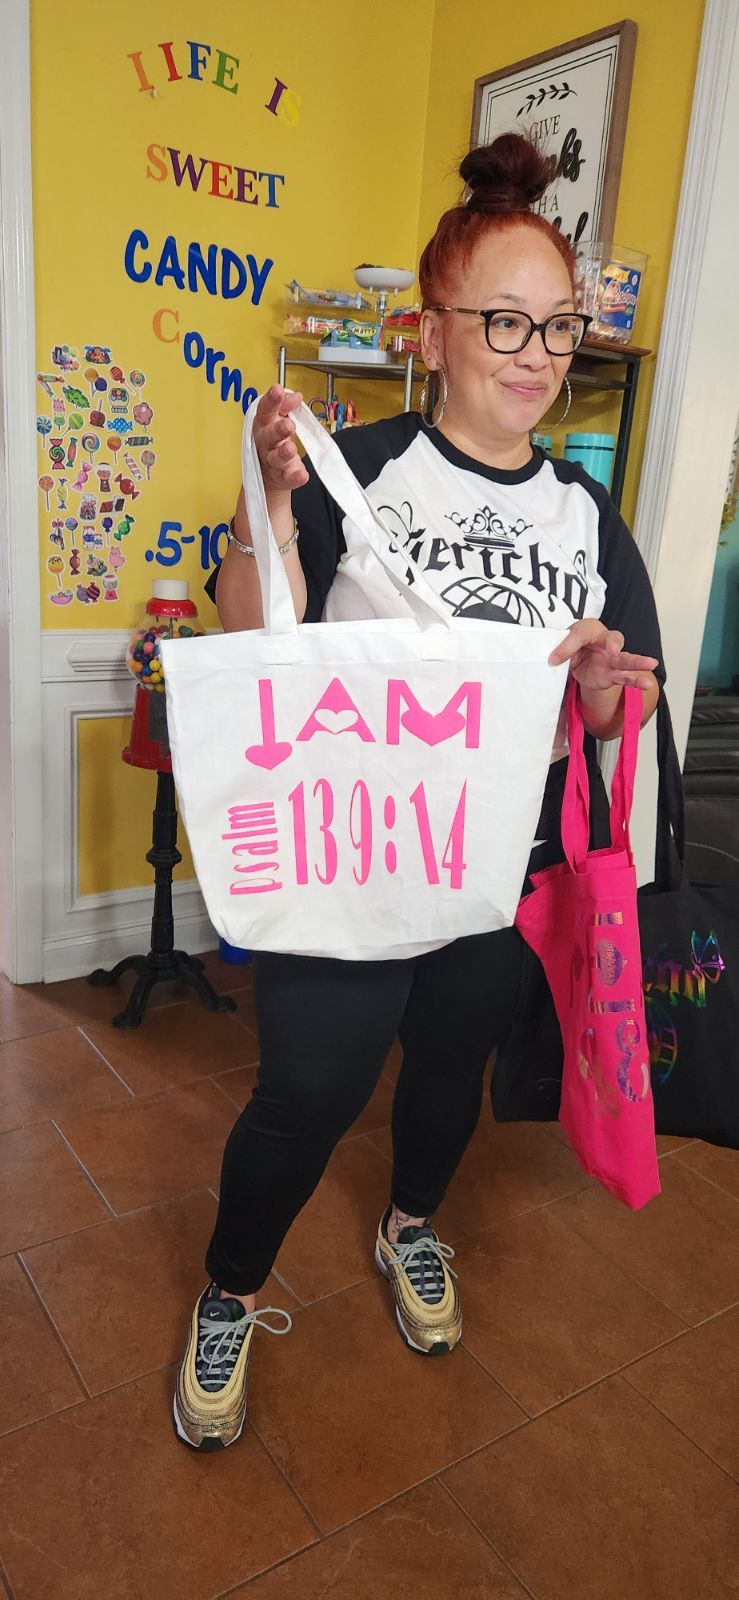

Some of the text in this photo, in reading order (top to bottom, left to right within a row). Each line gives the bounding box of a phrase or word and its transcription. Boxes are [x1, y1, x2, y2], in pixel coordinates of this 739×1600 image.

[265, 77, 300, 127] IS
[530, 115, 561, 141] GIVE
[146, 143, 285, 209] SWEET
[124, 229, 274, 306] CANDY
[144, 521, 230, 570] .5-10
[221, 802, 283, 895] psalm
